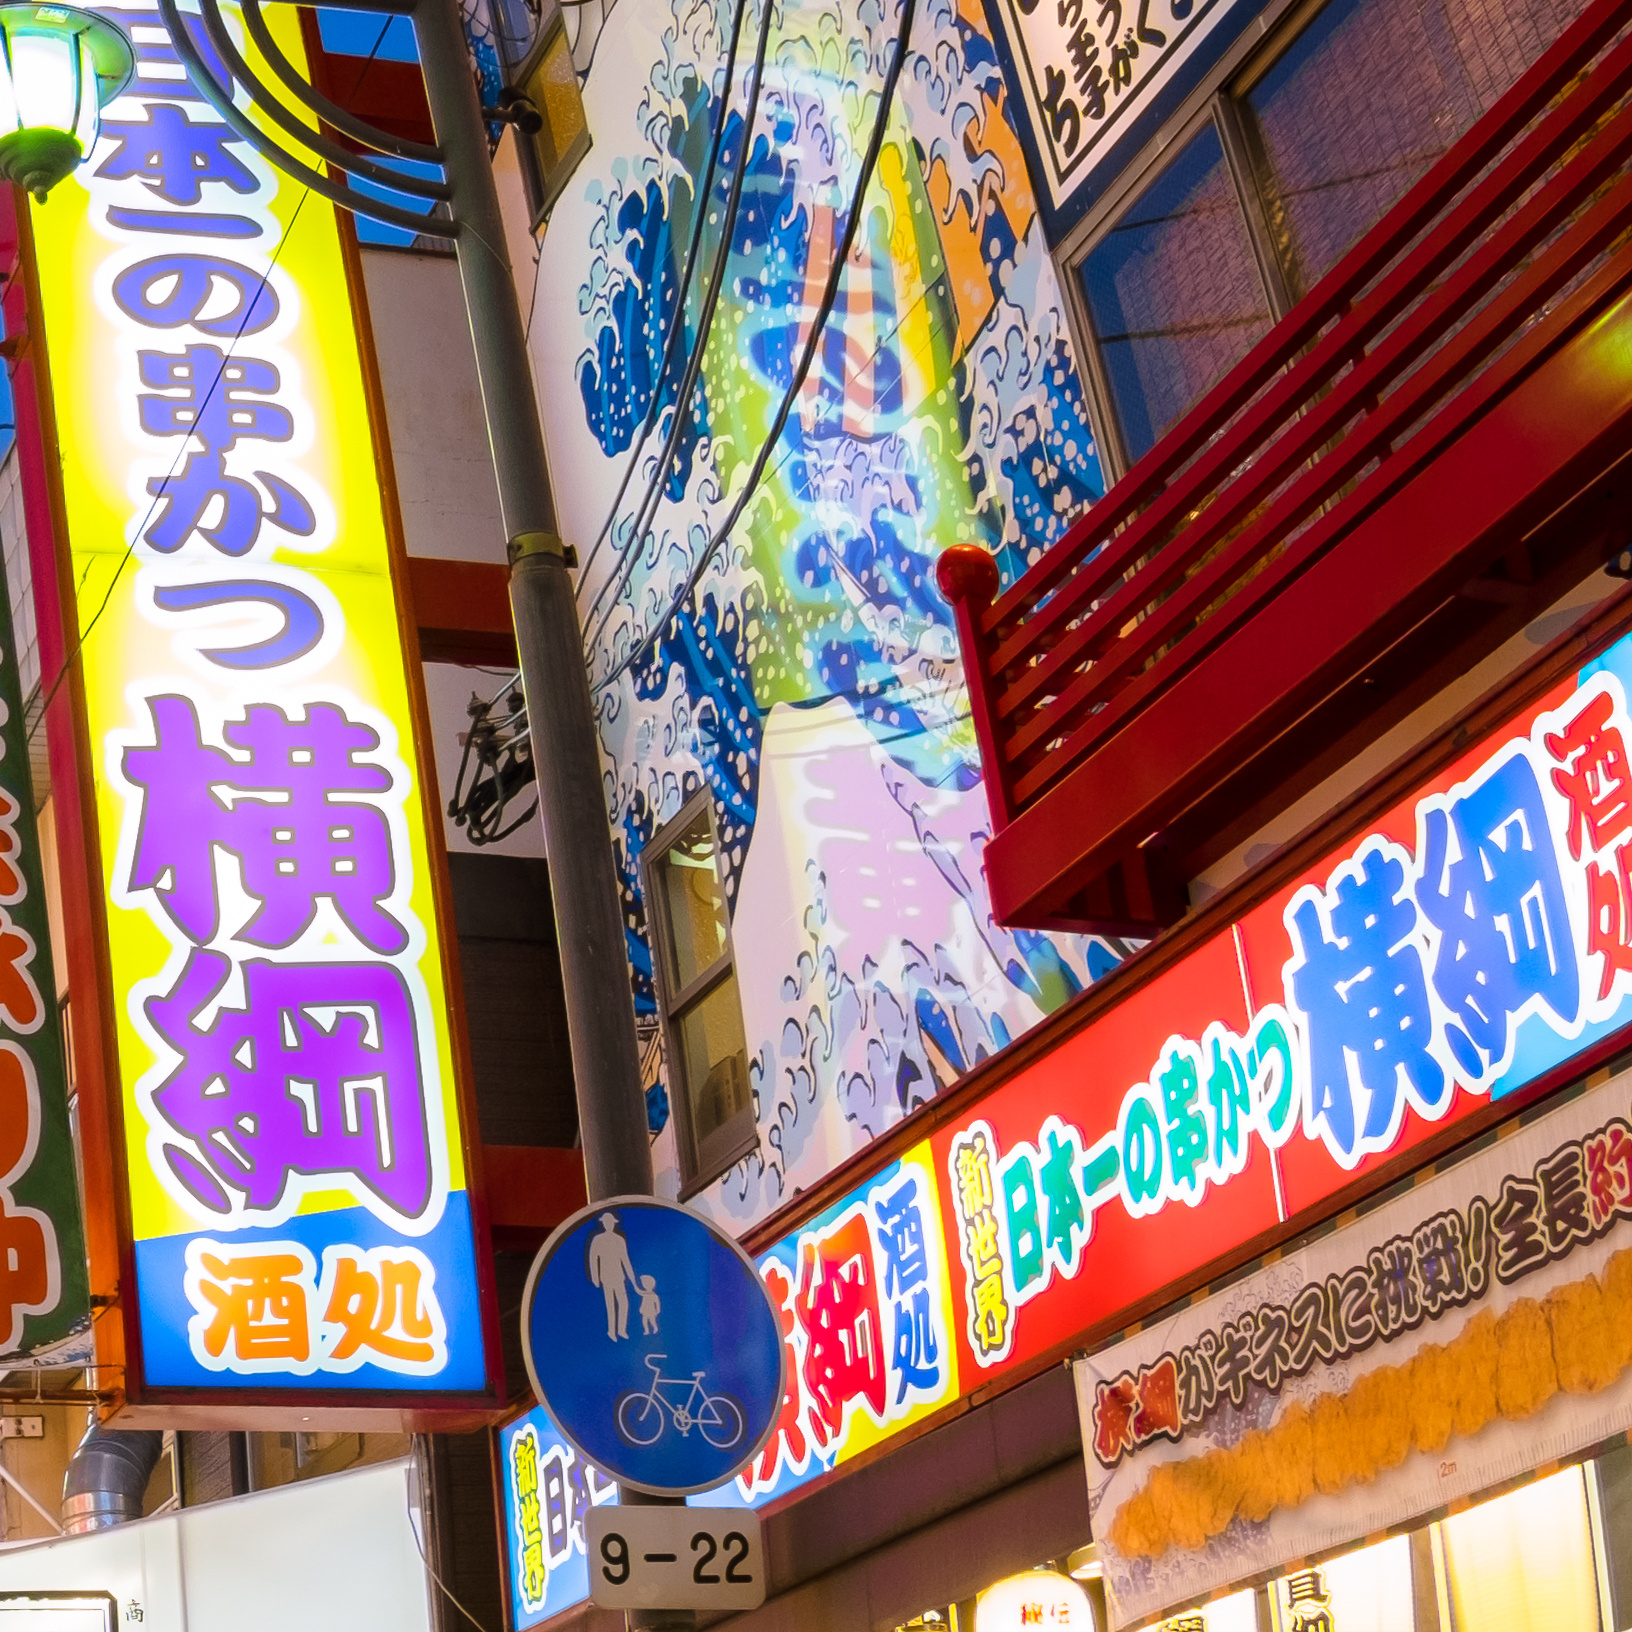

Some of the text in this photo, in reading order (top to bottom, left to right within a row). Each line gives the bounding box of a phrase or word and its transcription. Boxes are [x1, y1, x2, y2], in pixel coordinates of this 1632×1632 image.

[122, 693, 433, 1219] 横綱
[1290, 751, 1578, 1151] 横綱
[952, 1132, 1009, 1356] 新世界
[1001, 1006, 1299, 1290] 日本一の串かつ
[196, 1251, 435, 1363] 酒処
[874, 1179, 945, 1406] 酒処
[513, 1437, 544, 1602] 新世界
